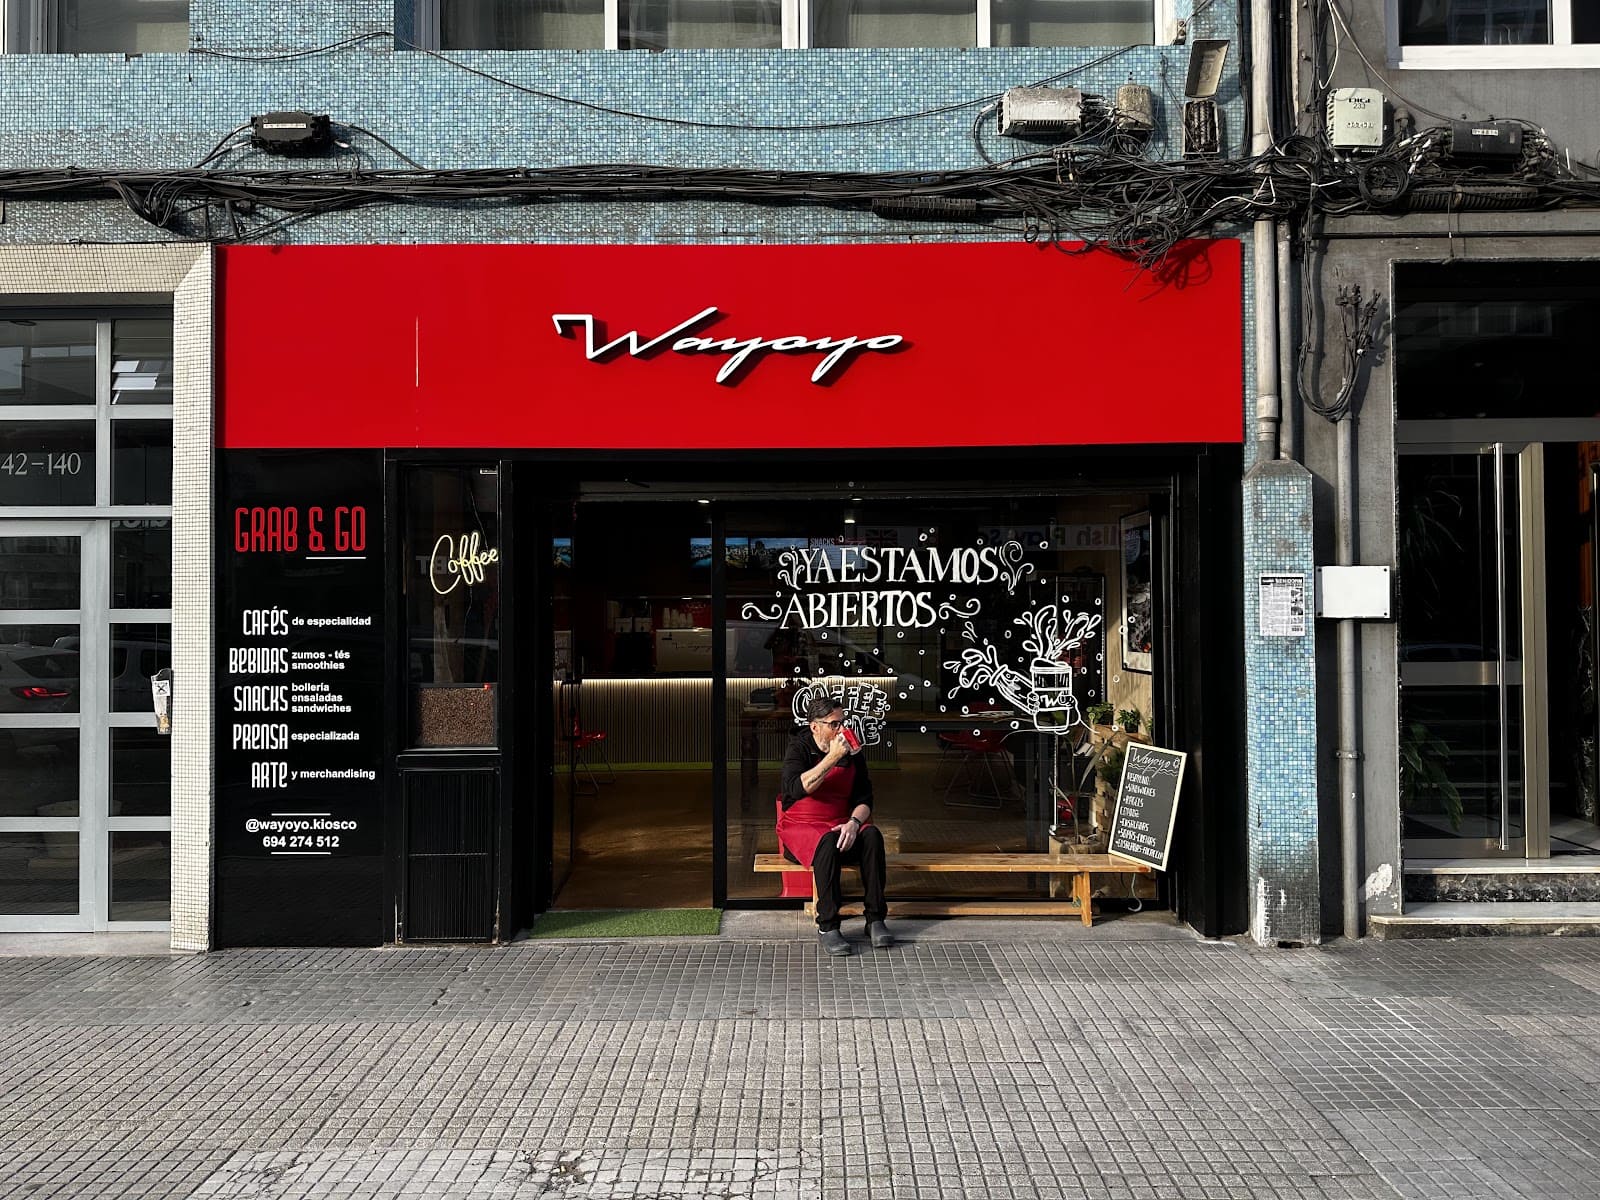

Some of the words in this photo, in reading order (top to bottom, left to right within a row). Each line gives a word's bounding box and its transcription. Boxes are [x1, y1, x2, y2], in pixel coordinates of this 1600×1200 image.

[552, 307, 903, 383] Wayoyo
[235, 507, 298, 552] GRAB
[308, 507, 326, 552] &
[334, 507, 366, 552] GO
[430, 532, 499, 594] Coffee
[799, 547, 836, 584] YA
[839, 547, 998, 584] ESTAMOS
[779, 590, 937, 629] ABIERTOS
[291, 616, 305, 626] de
[306, 616, 372, 628] especialidad
[291, 651, 325, 660] zumos
[334, 649, 351, 660] tés
[291, 660, 346, 670] smoothies
[291, 682, 330, 693] bollería
[291, 692, 344, 703] ensaladas
[291, 703, 352, 713] sandwiches
[291, 730, 360, 742] especializada
[1129, 747, 1170, 778] Wayoyo
[291, 770, 298, 781] y
[299, 768, 376, 781] merchandising
[245, 818, 358, 833] @wayoyo.kiosco
[262, 835, 287, 848] 694
[289, 835, 314, 848] 274
[316, 835, 340, 848] 512
